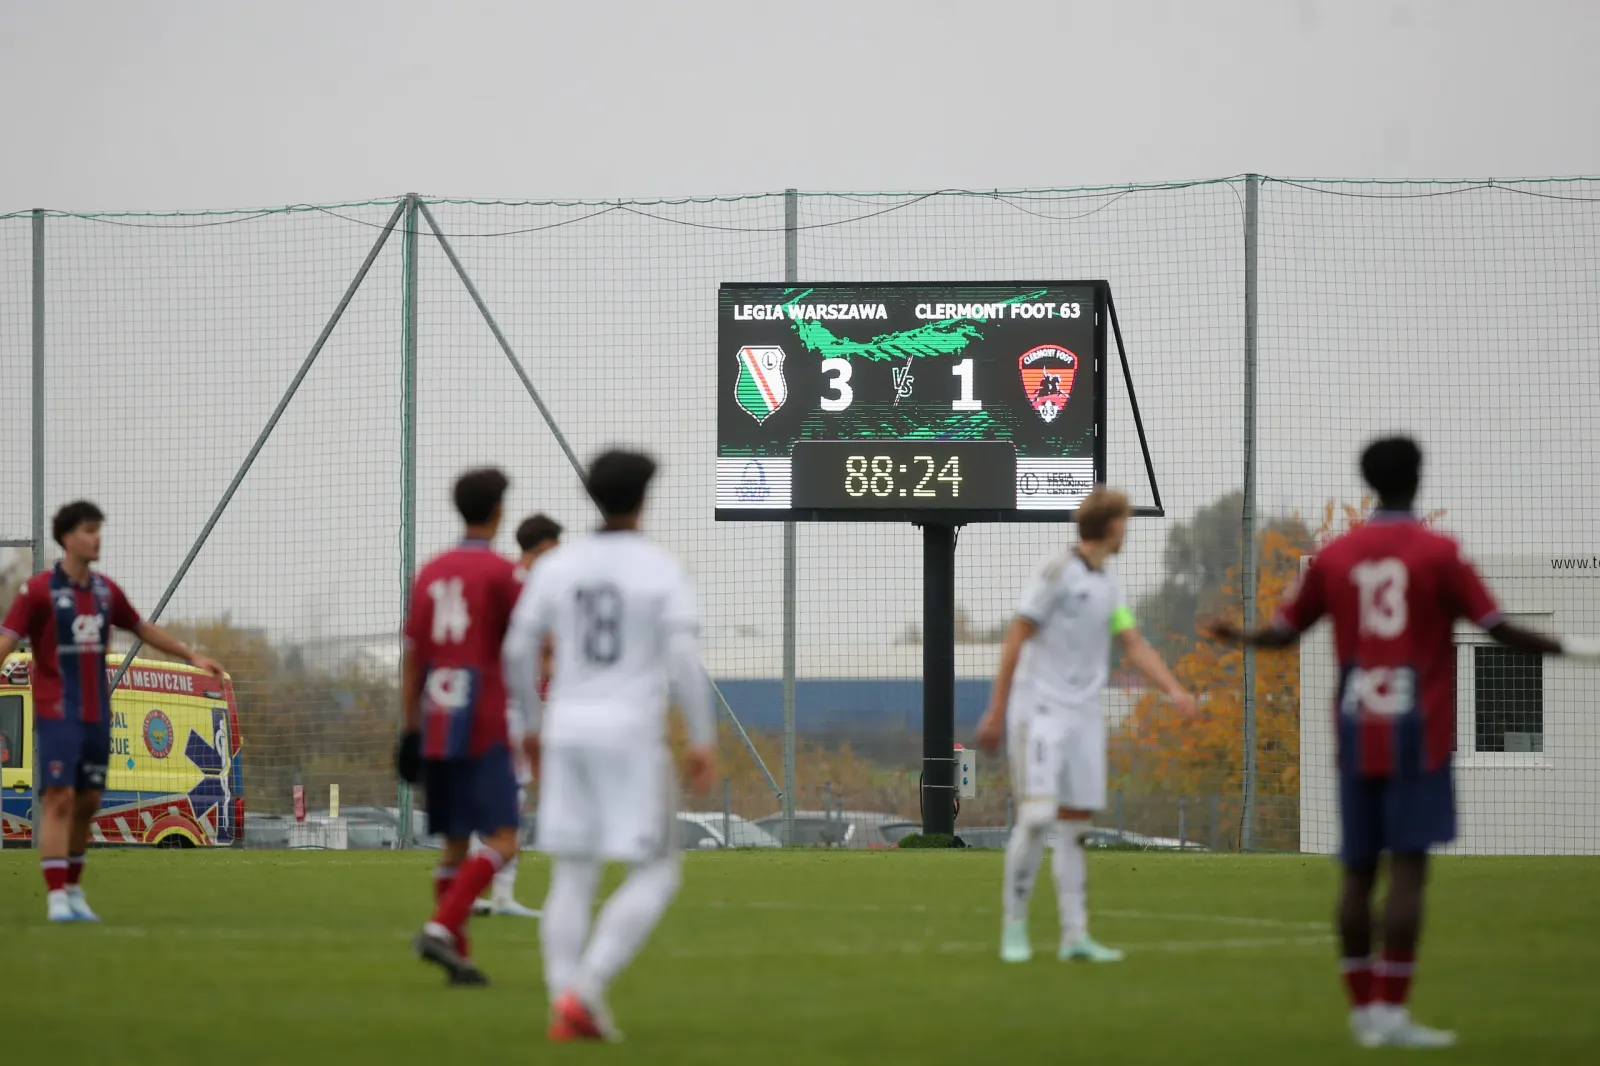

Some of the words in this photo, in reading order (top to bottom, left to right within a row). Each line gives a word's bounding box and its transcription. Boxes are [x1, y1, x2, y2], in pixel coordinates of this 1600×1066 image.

[734, 304, 784, 320] LEGIA
[788, 303, 888, 320] WARSZAWA
[915, 303, 1007, 319] CLERMONT
[1010, 303, 1055, 319] FOOT
[1060, 303, 1081, 319] 63
[1024, 348, 1056, 365] CLERMONT
[1056, 350, 1074, 364] FOOT
[820, 358, 853, 411] 3
[952, 358, 982, 410] 1
[845, 455, 963, 497] 88:24
[1551, 555, 1600, 569] www.t
[1351, 556, 1408, 639] 13
[132, 670, 194, 692] MEDYCZNE
